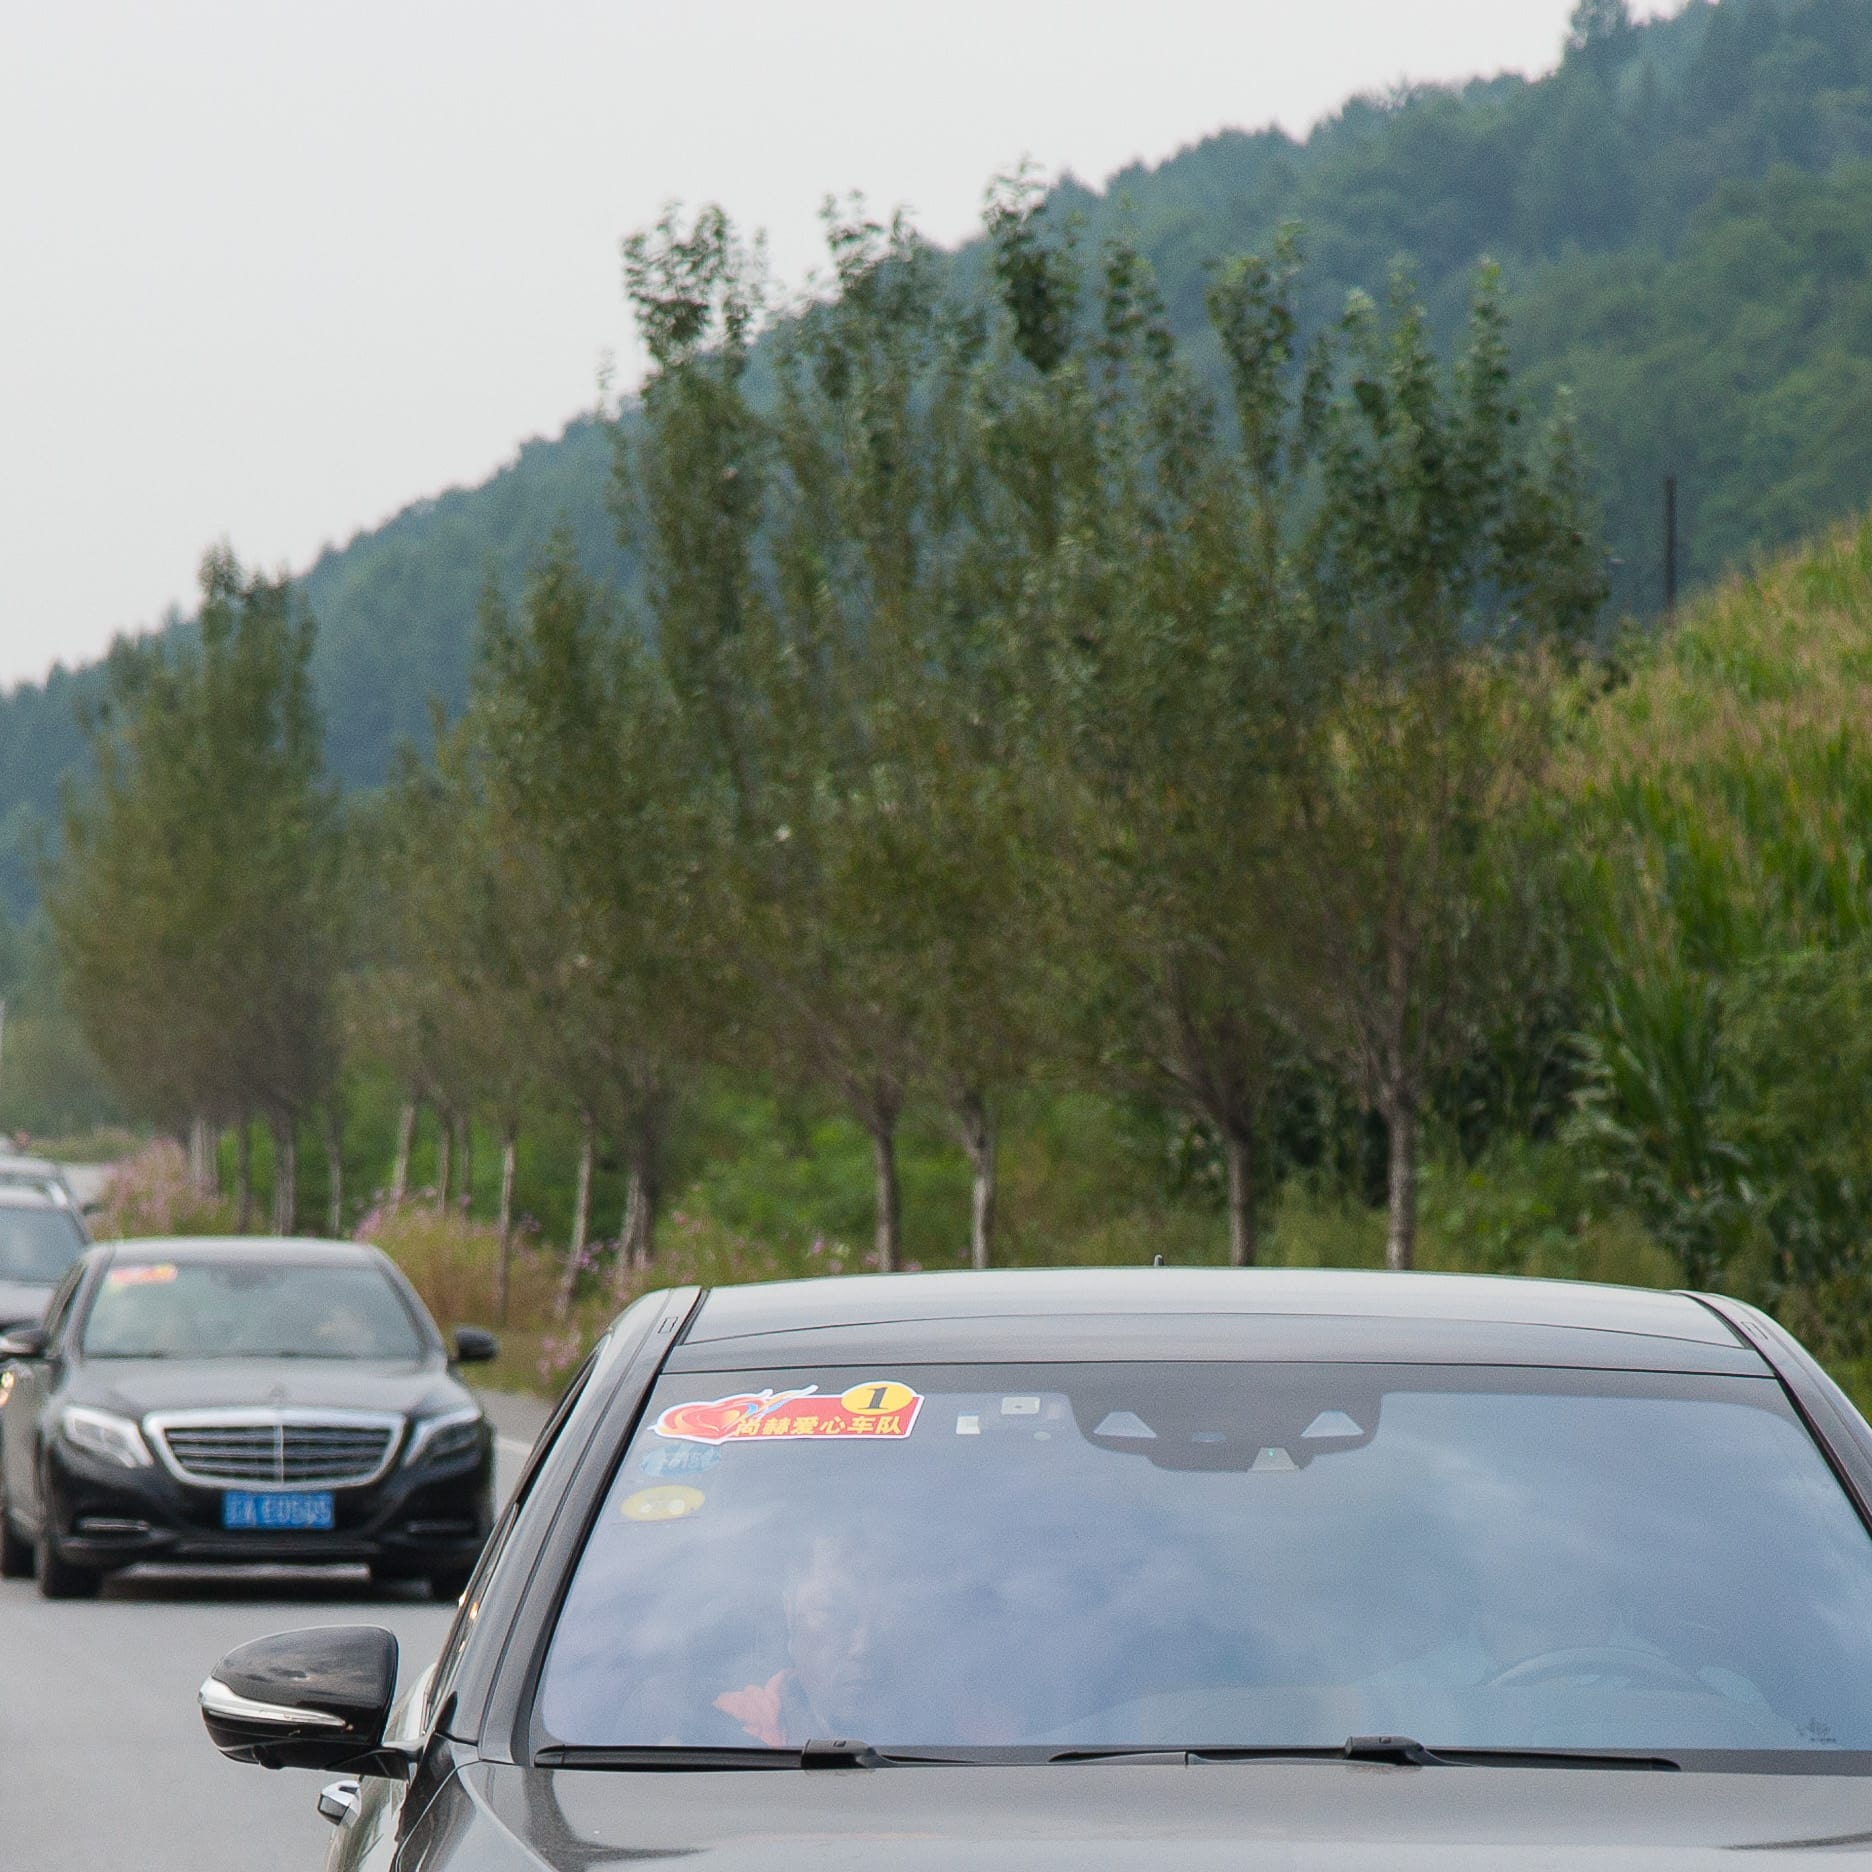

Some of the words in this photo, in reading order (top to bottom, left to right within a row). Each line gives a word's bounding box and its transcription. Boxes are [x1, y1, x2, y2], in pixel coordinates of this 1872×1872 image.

[858, 1387, 888, 1410] 1
[735, 1415, 903, 1437] 尚赫爱心车队
